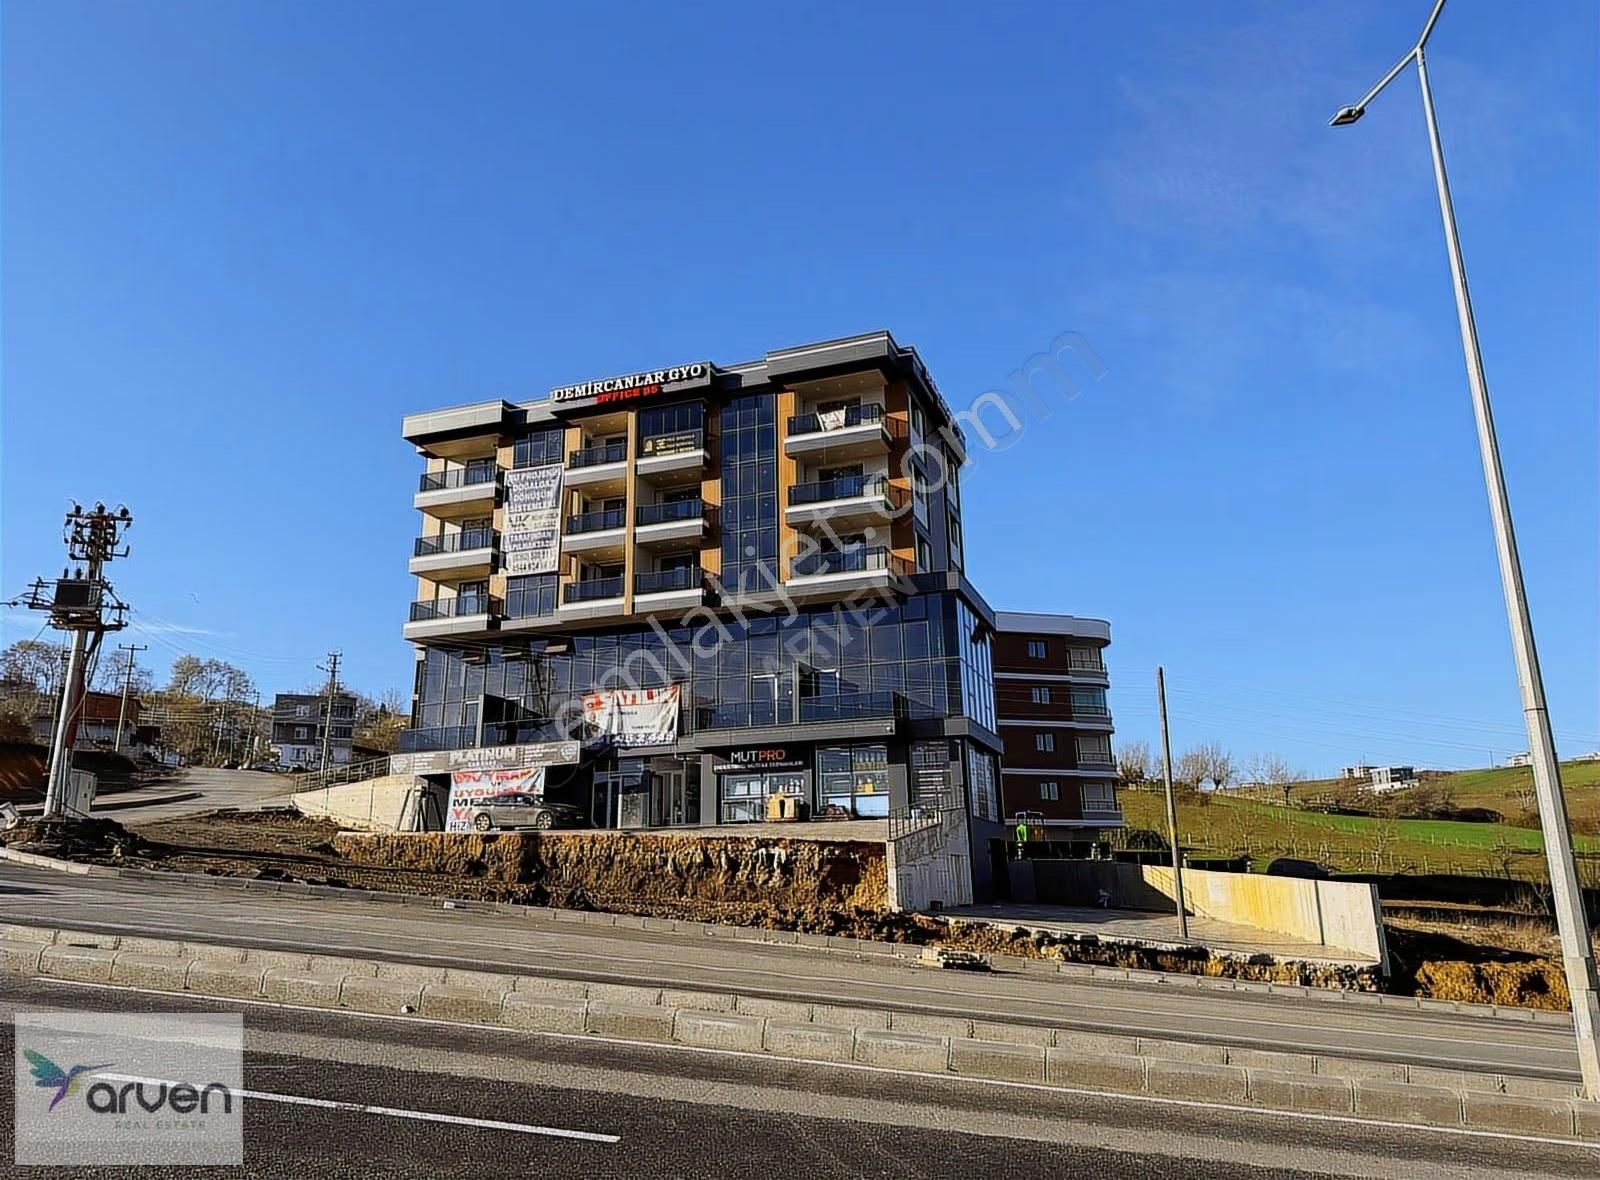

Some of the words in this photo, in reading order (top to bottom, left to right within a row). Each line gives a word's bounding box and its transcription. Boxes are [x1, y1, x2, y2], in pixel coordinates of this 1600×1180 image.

[554, 373, 664, 400] DEMİRCANLAR
[668, 364, 701, 381] GYO
[731, 750, 785, 763] MUTPRO
